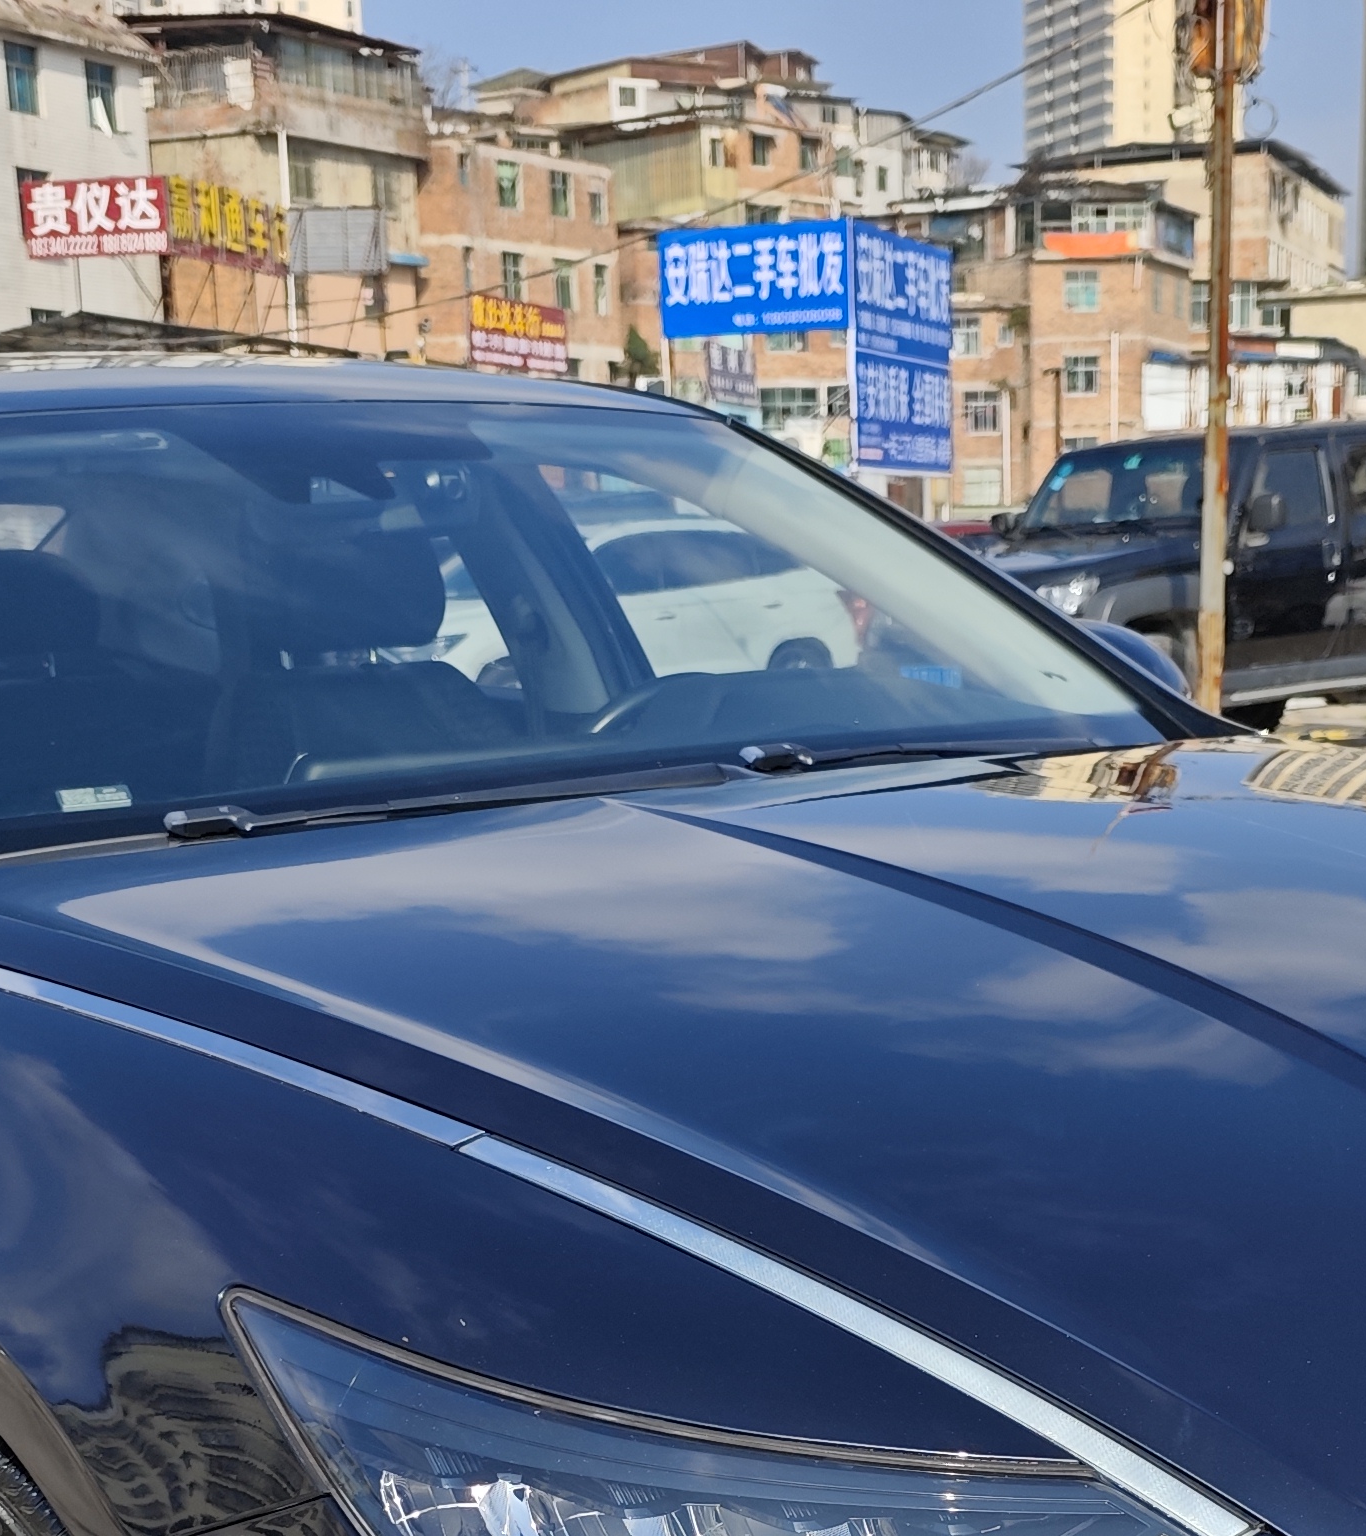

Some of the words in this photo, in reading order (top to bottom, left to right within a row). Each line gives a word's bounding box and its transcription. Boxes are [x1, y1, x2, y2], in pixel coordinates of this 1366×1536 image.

[26, 177, 162, 237] 贵仪达
[663, 230, 845, 308] 安瑞达二手车批发
